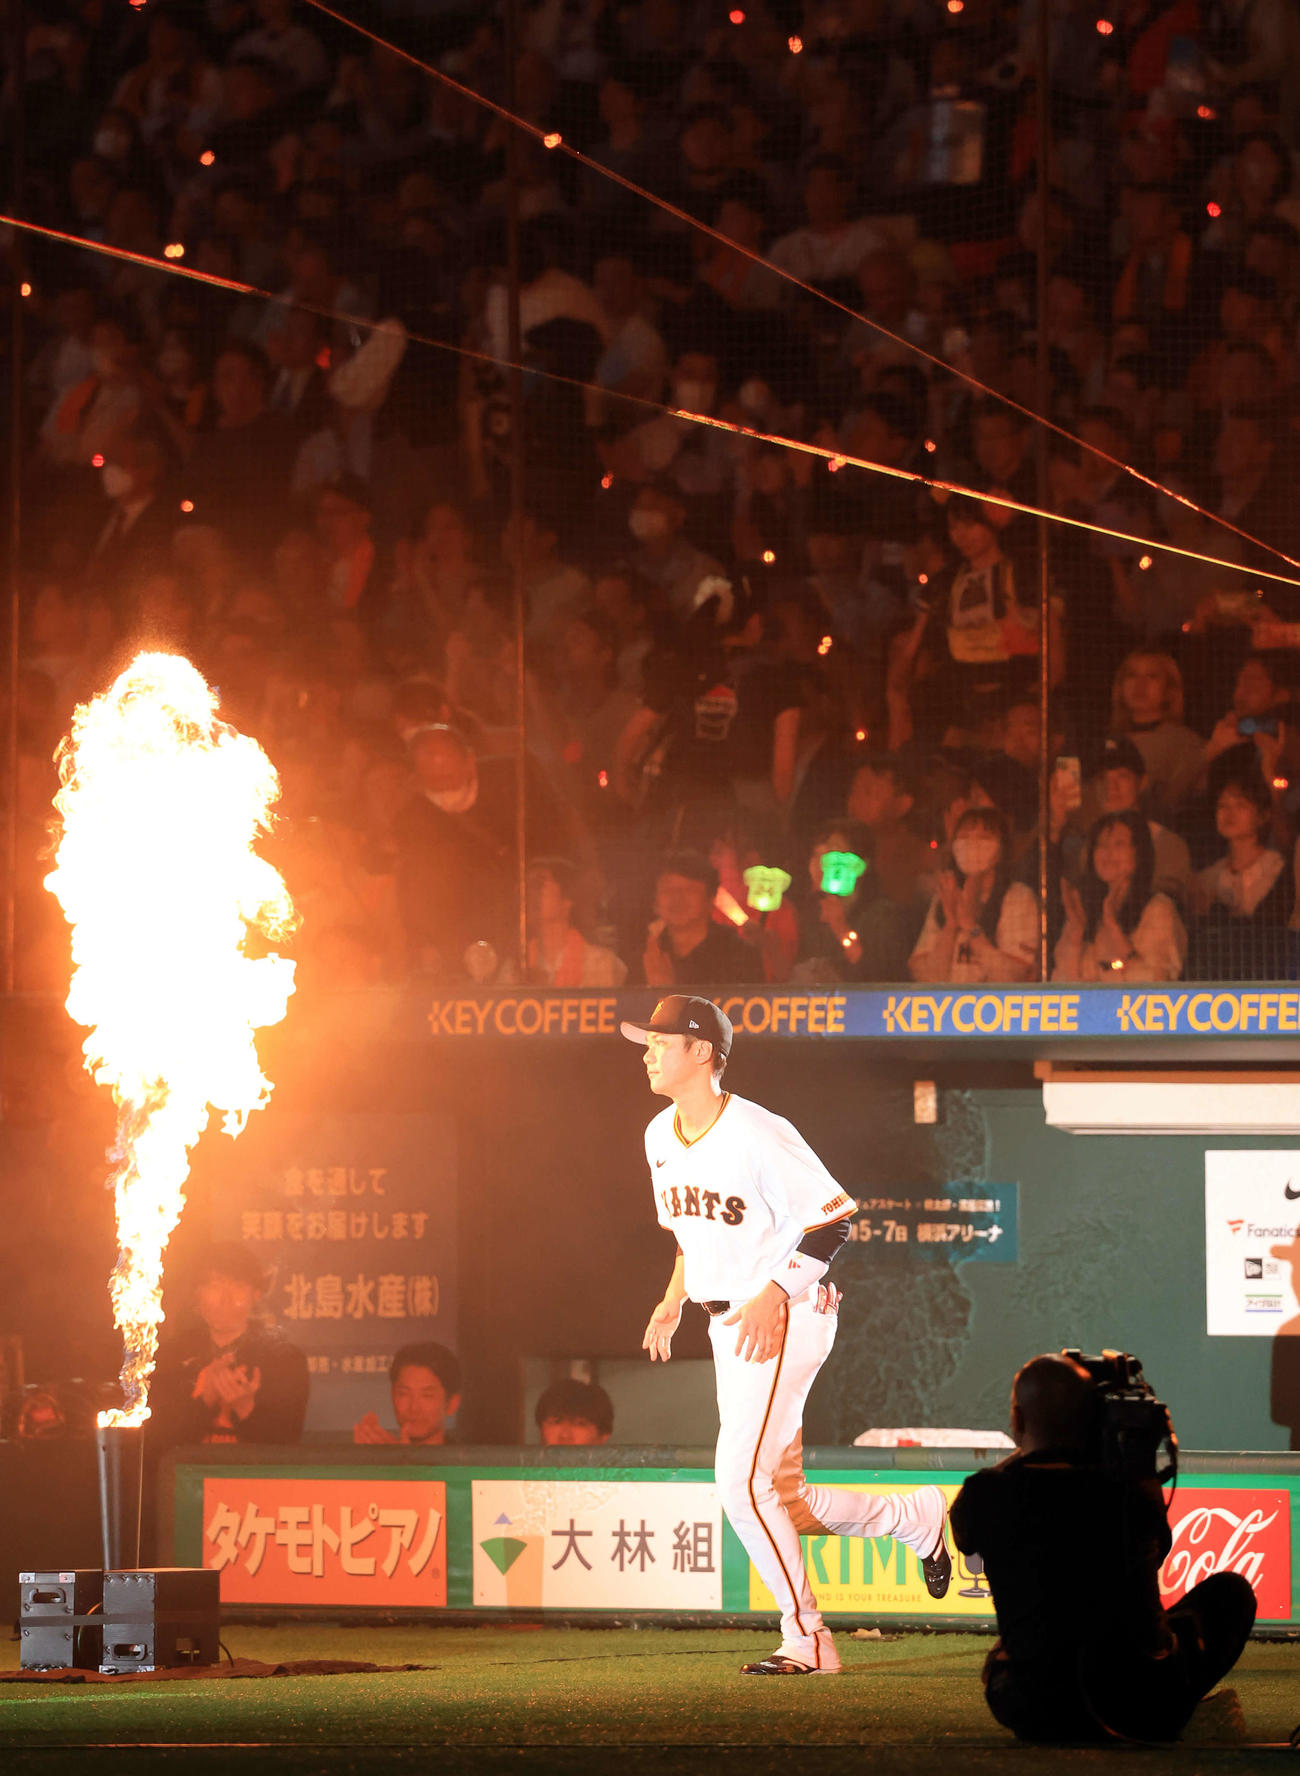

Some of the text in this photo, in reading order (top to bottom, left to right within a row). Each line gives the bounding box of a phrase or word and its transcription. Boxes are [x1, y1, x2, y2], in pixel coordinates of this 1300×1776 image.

[714, 996, 847, 1034] COFFEE
[1116, 993, 1300, 1032] KEYCOFFE
[661, 1185, 747, 1226] ANTS
[205, 1501, 443, 1578] タケモトピアノ
[551, 1518, 716, 1573] 大林組
[848, 1592, 873, 1602] YOUR
[876, 1593, 922, 1603] TREASURE
